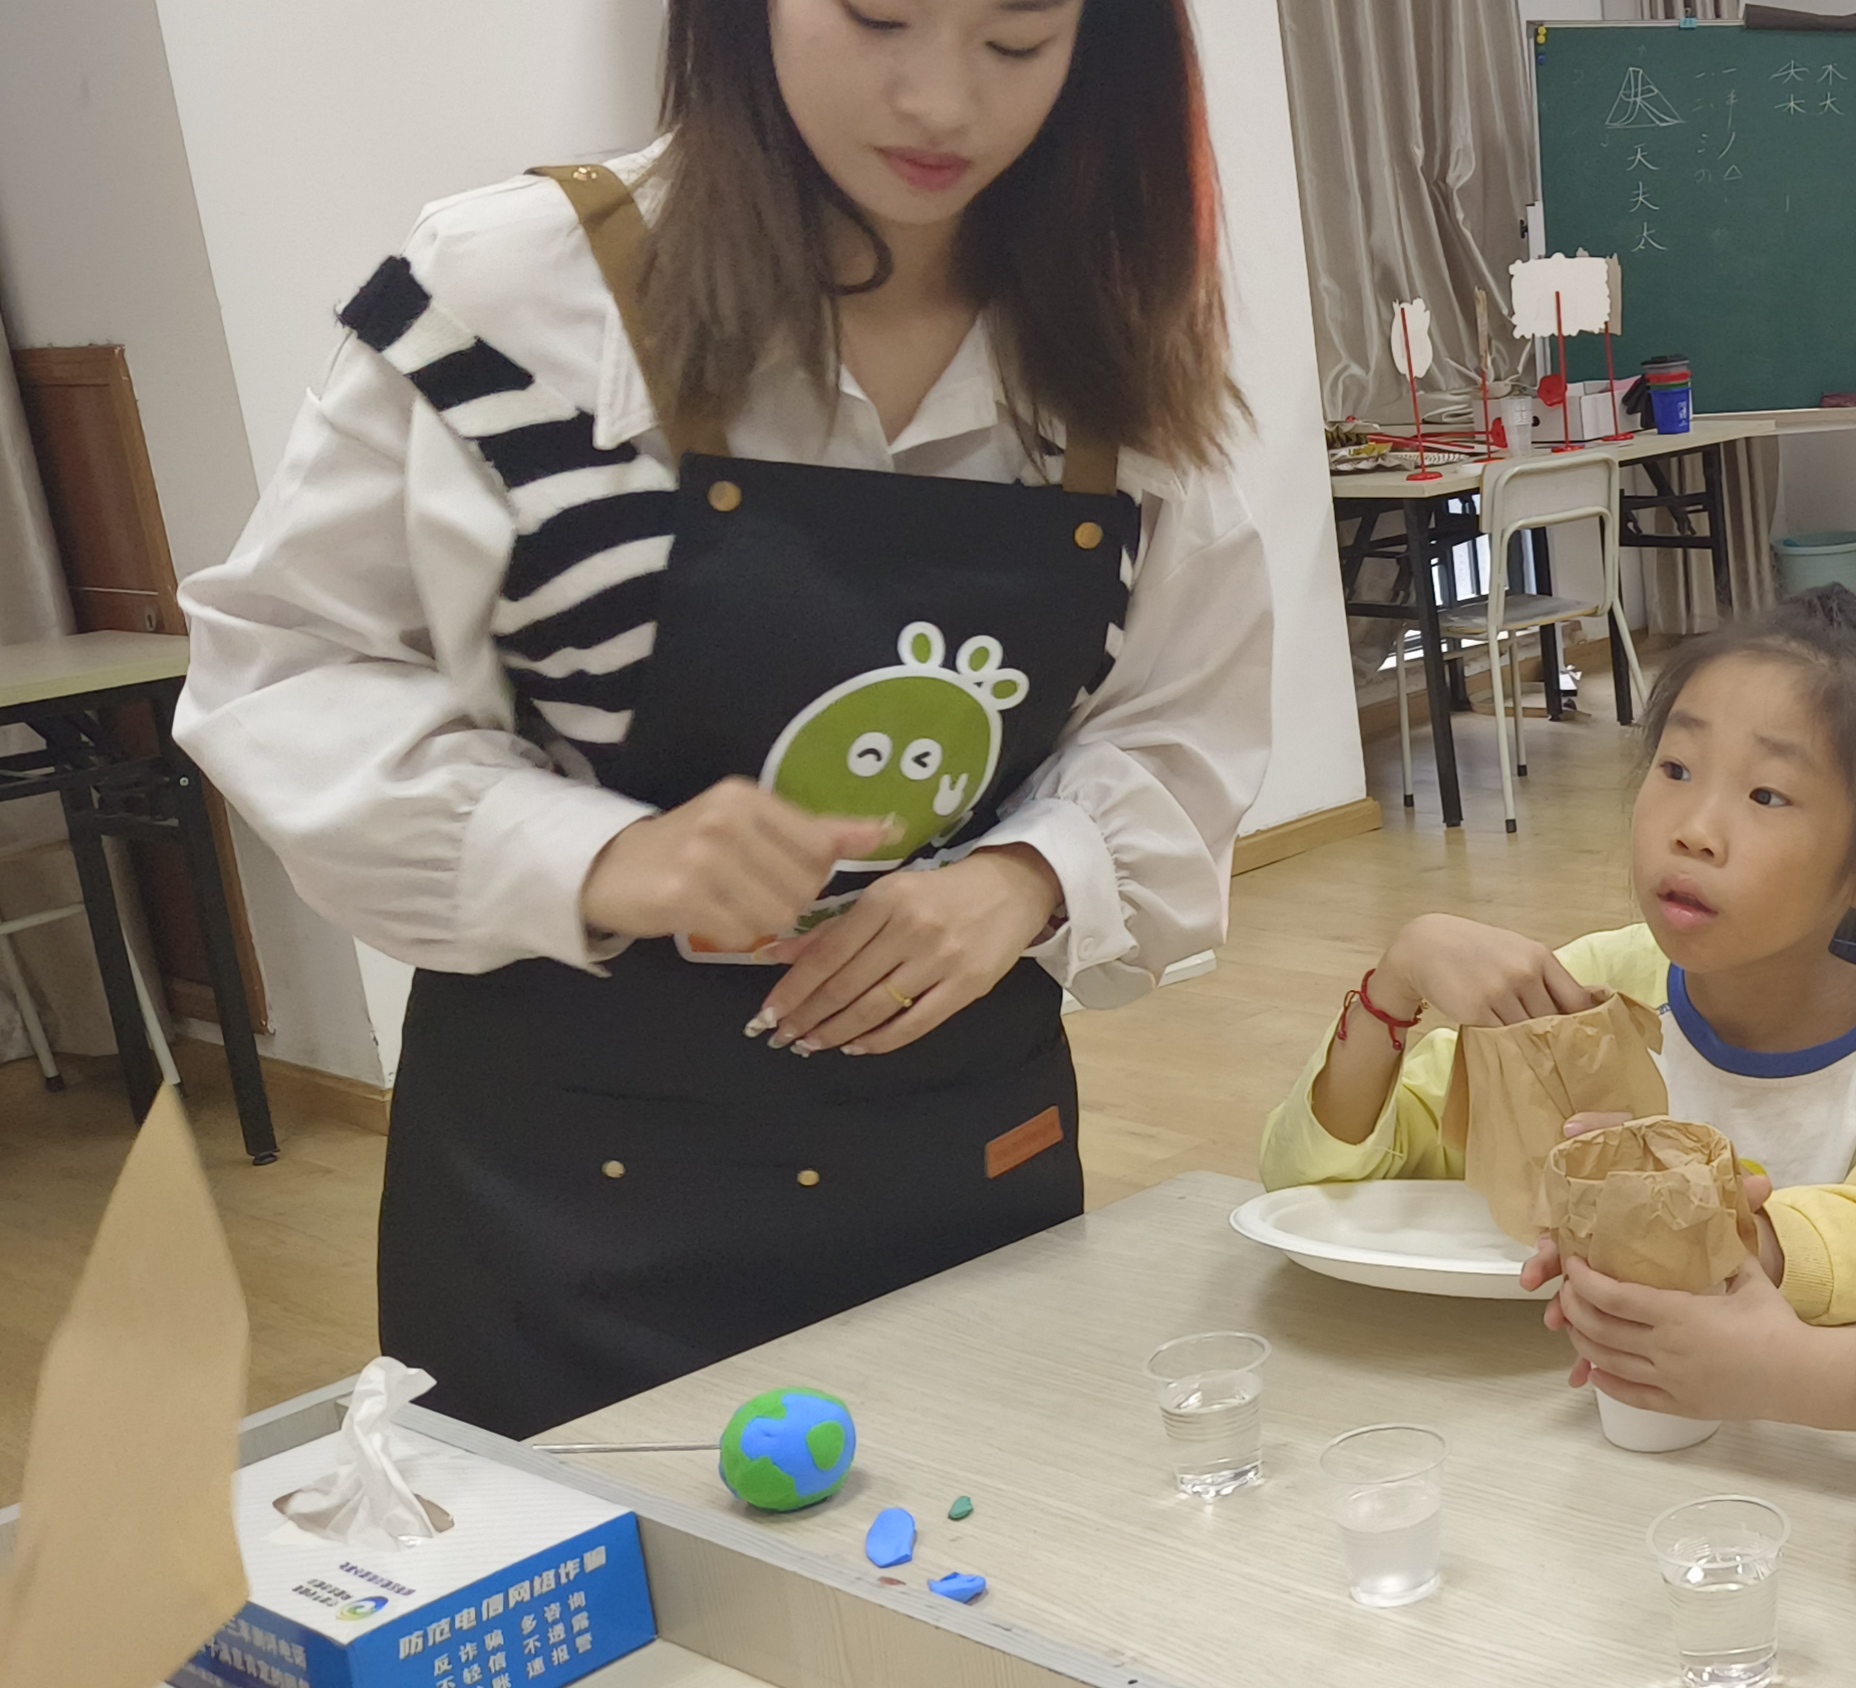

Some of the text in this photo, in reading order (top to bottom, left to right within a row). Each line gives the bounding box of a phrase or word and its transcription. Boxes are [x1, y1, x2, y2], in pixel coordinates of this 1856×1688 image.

[398, 1545, 607, 1661] 防范电信网络诈骗
